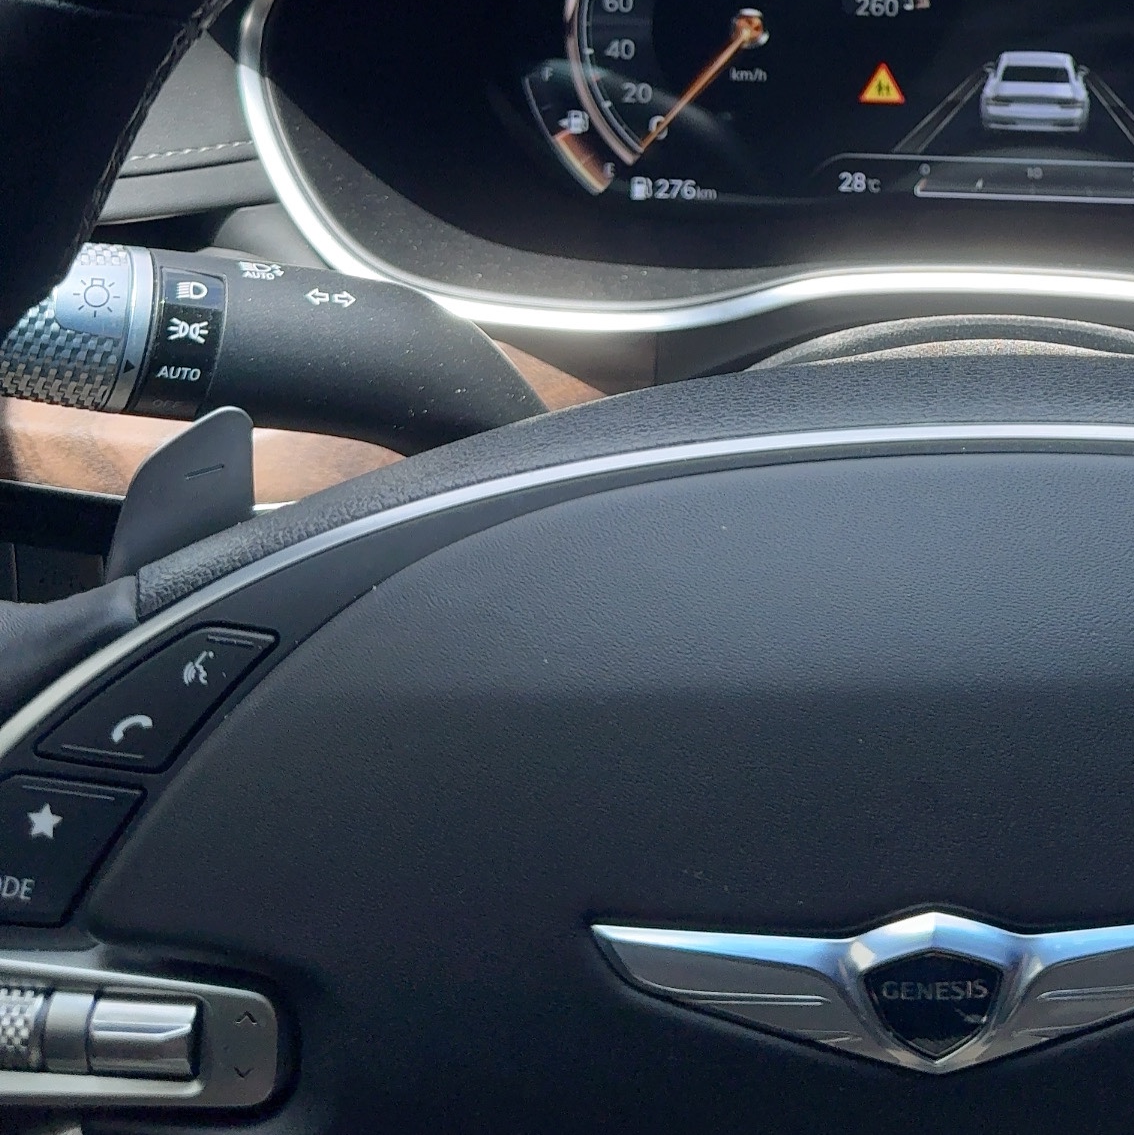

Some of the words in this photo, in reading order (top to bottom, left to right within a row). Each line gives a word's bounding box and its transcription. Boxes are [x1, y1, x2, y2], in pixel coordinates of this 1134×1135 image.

[604, 38, 636, 61] 40
[730, 66, 768, 82] km/h
[621, 82, 653, 104] 20
[242, 270, 276, 281] AUTO
[156, 365, 202, 382] AUTO
[0, 875, 35, 900] DE
[881, 978, 989, 1001] GENESIS
